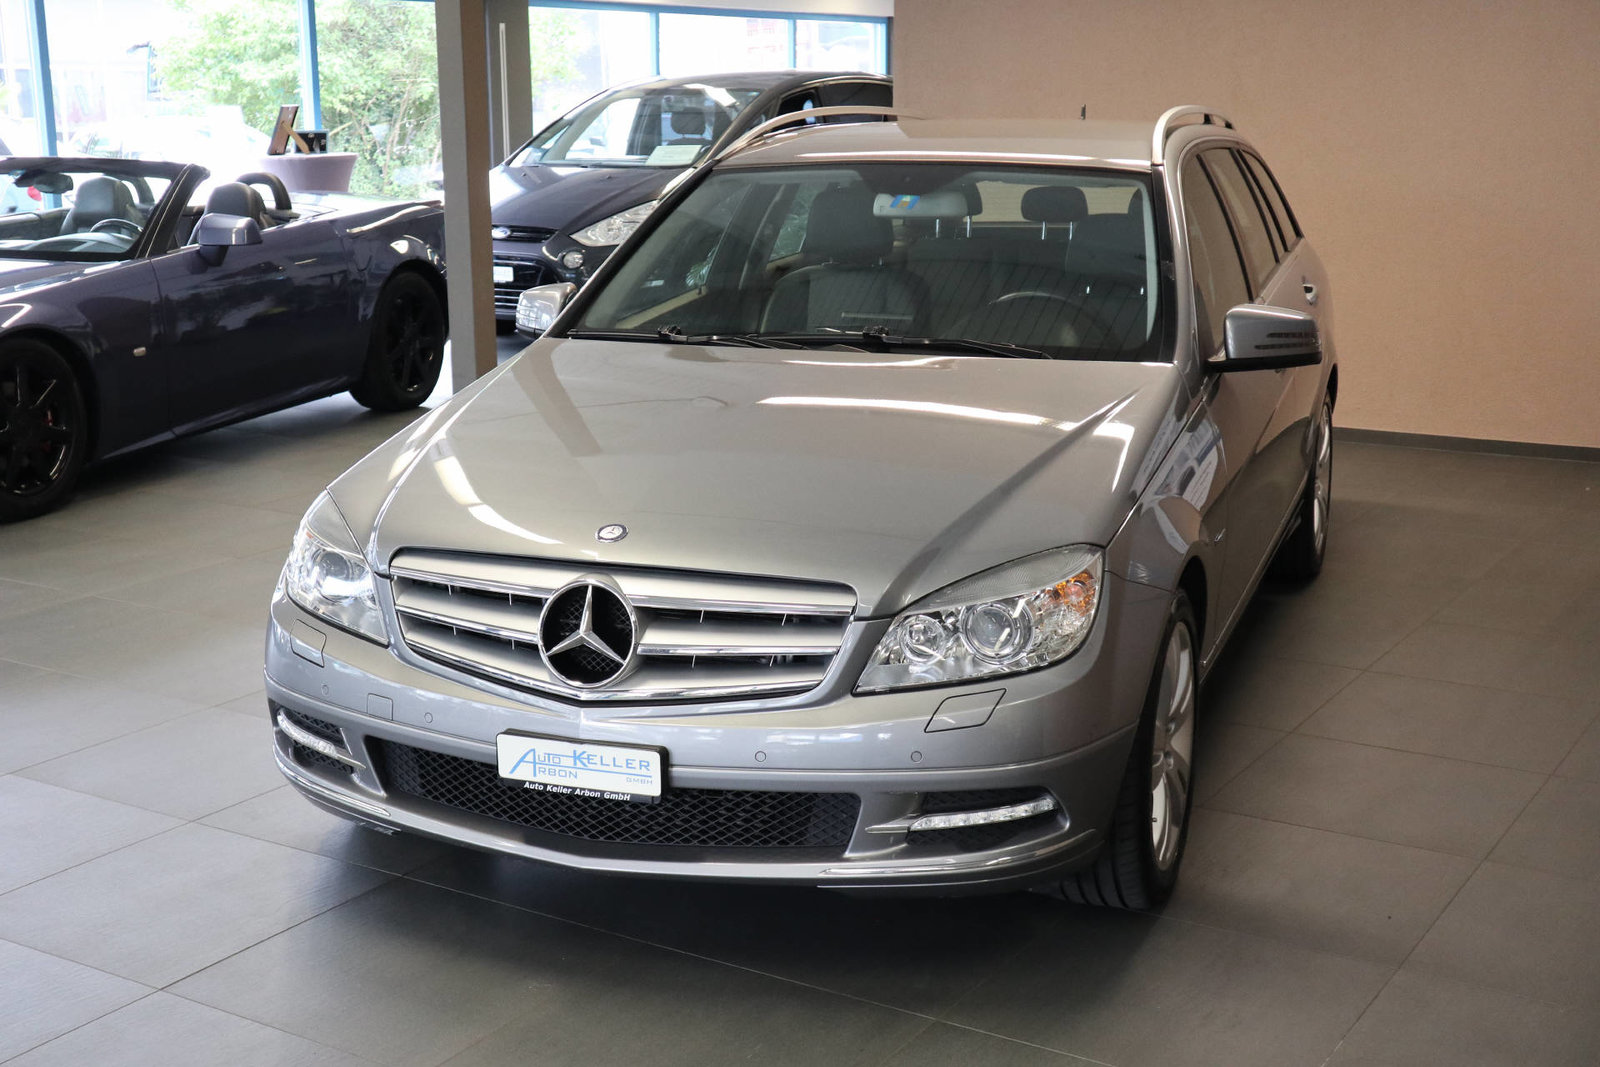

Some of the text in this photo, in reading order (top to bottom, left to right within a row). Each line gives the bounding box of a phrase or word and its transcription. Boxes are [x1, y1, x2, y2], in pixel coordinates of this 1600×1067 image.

[573, 749, 650, 772] KELLER
[523, 781, 631, 801] Auto Keller Arbon GmbH
